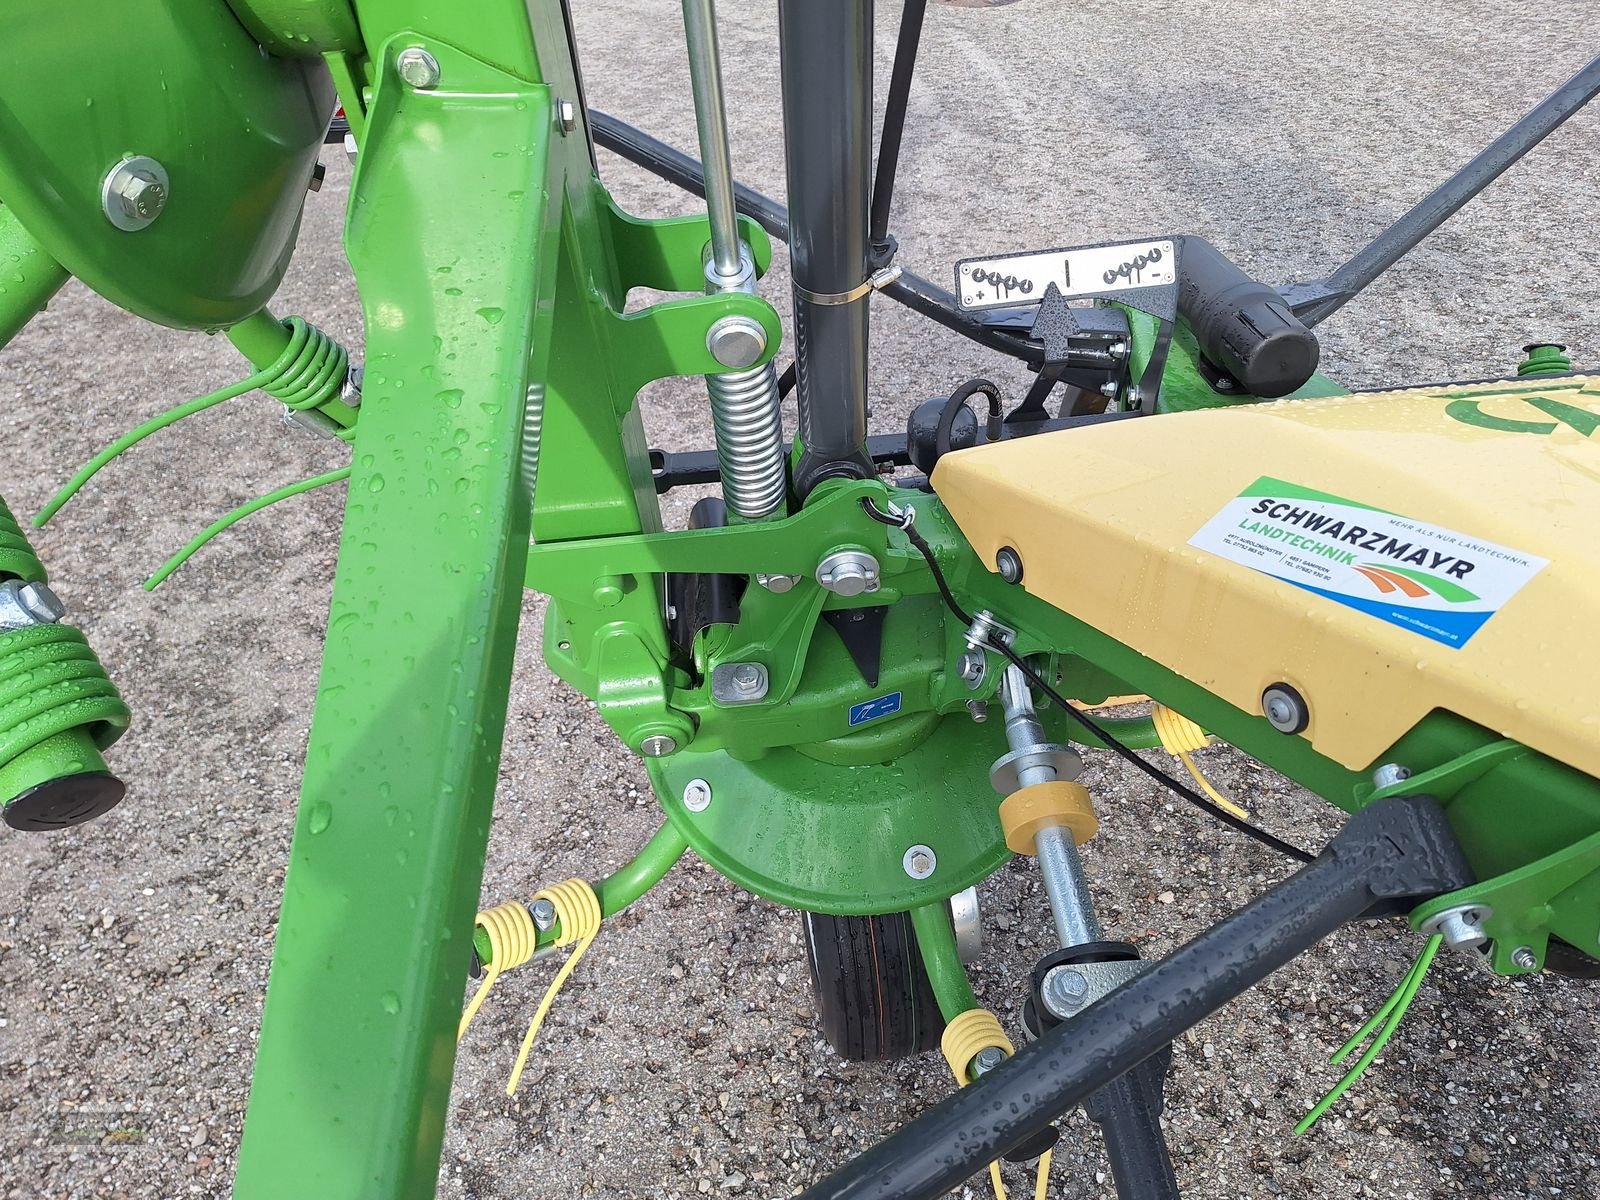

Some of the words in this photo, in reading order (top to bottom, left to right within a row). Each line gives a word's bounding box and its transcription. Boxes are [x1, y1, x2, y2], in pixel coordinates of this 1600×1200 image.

[1238, 518, 1358, 565] LANDTECHNIK
[1251, 498, 1475, 580] SCHWARZMAYR
[1389, 519, 1415, 531] MEHR
[1416, 527, 1434, 537] ALS
[1436, 533, 1456, 544] NUR
